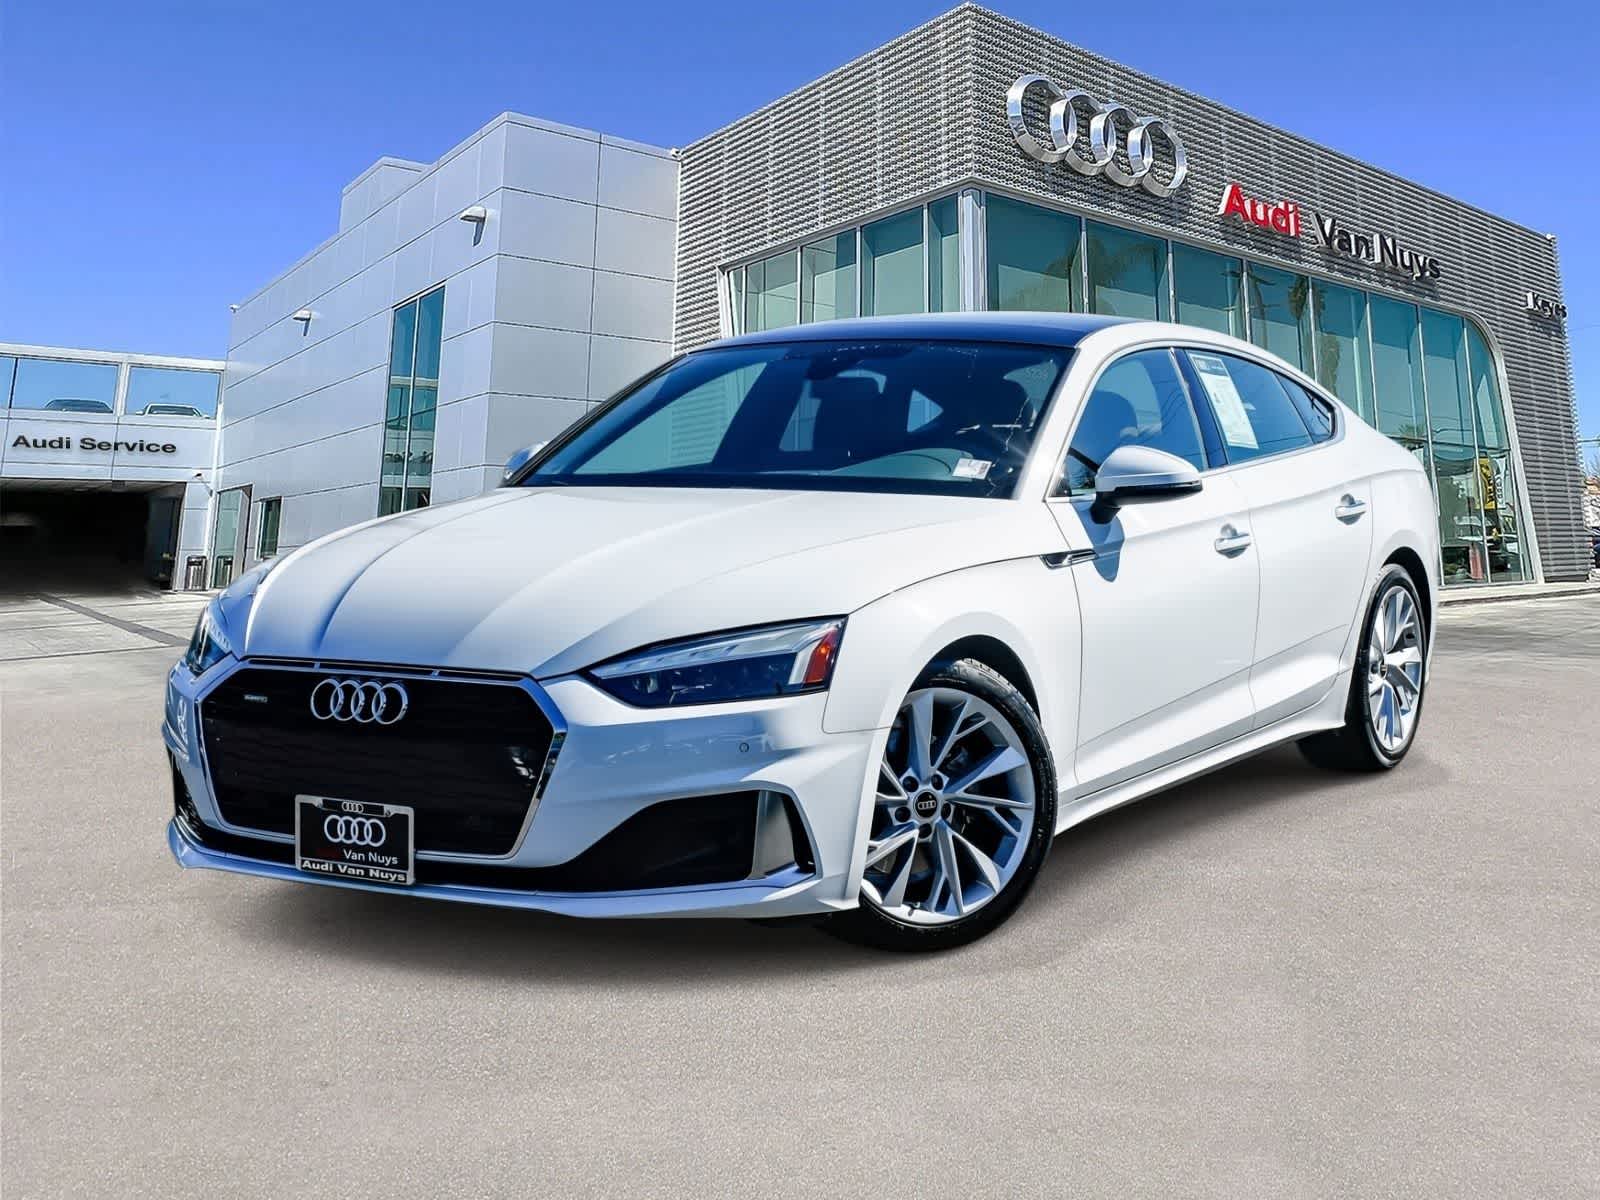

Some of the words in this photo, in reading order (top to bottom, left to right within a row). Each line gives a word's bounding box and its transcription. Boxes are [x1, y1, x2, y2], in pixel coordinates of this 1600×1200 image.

[1217, 182, 1301, 239] Audi
[1311, 212, 1371, 258] Van
[1374, 233, 1441, 281] Nuys
[12, 435, 71, 449] Audi
[80, 437, 177, 453] Service
[343, 849, 365, 861] Van
[368, 852, 398, 866] Nuys
[301, 860, 333, 872] Audi
[337, 864, 365, 876] Van
[369, 869, 406, 881] Nuys
